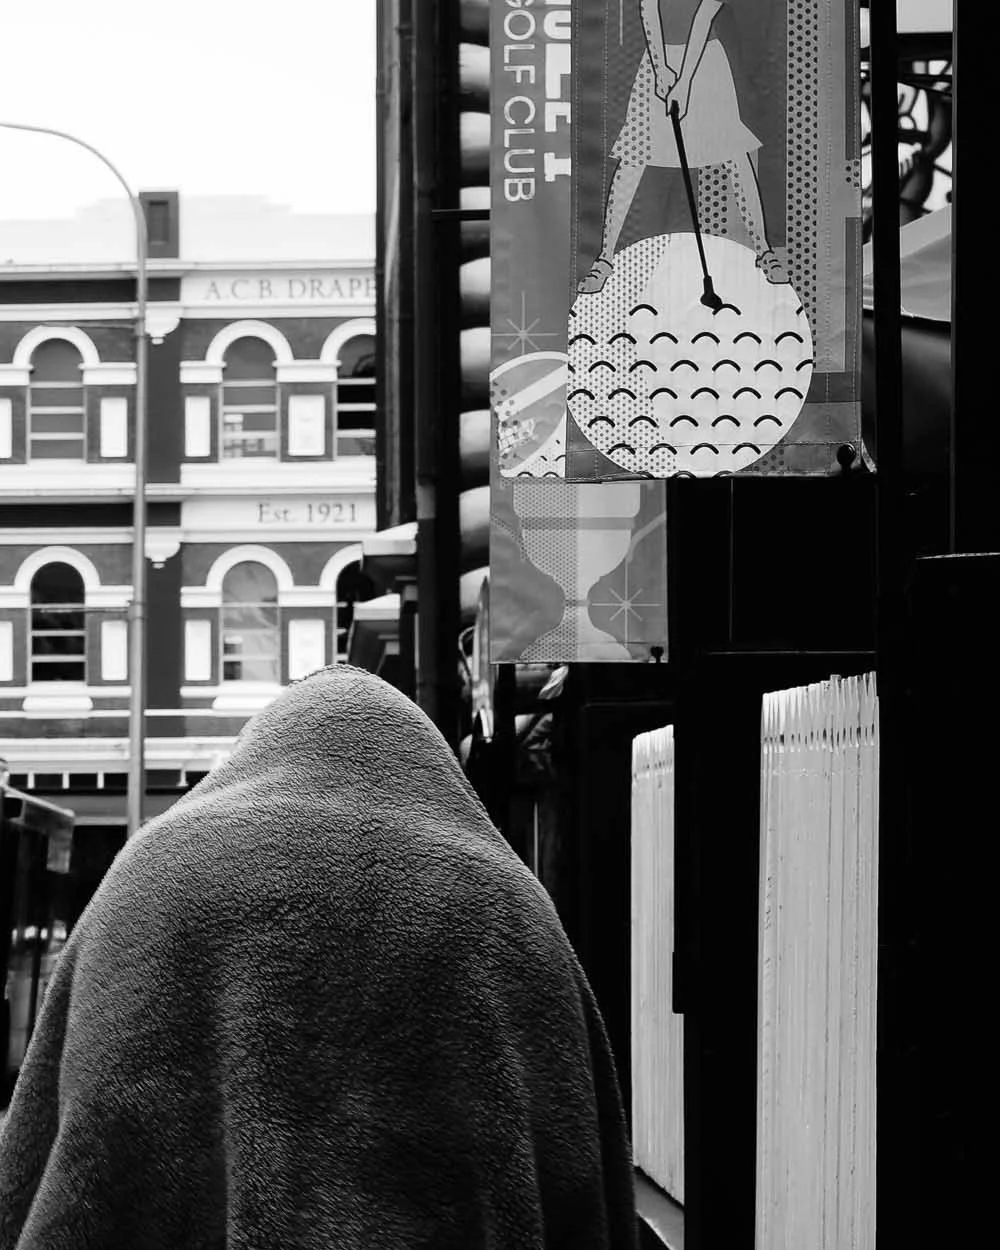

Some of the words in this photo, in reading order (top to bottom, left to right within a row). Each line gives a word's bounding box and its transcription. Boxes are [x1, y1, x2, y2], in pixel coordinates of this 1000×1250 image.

[504, 0, 535, 84] OLF
[504, 96, 535, 201] CLUB
[308, 503, 356, 523] 1921
